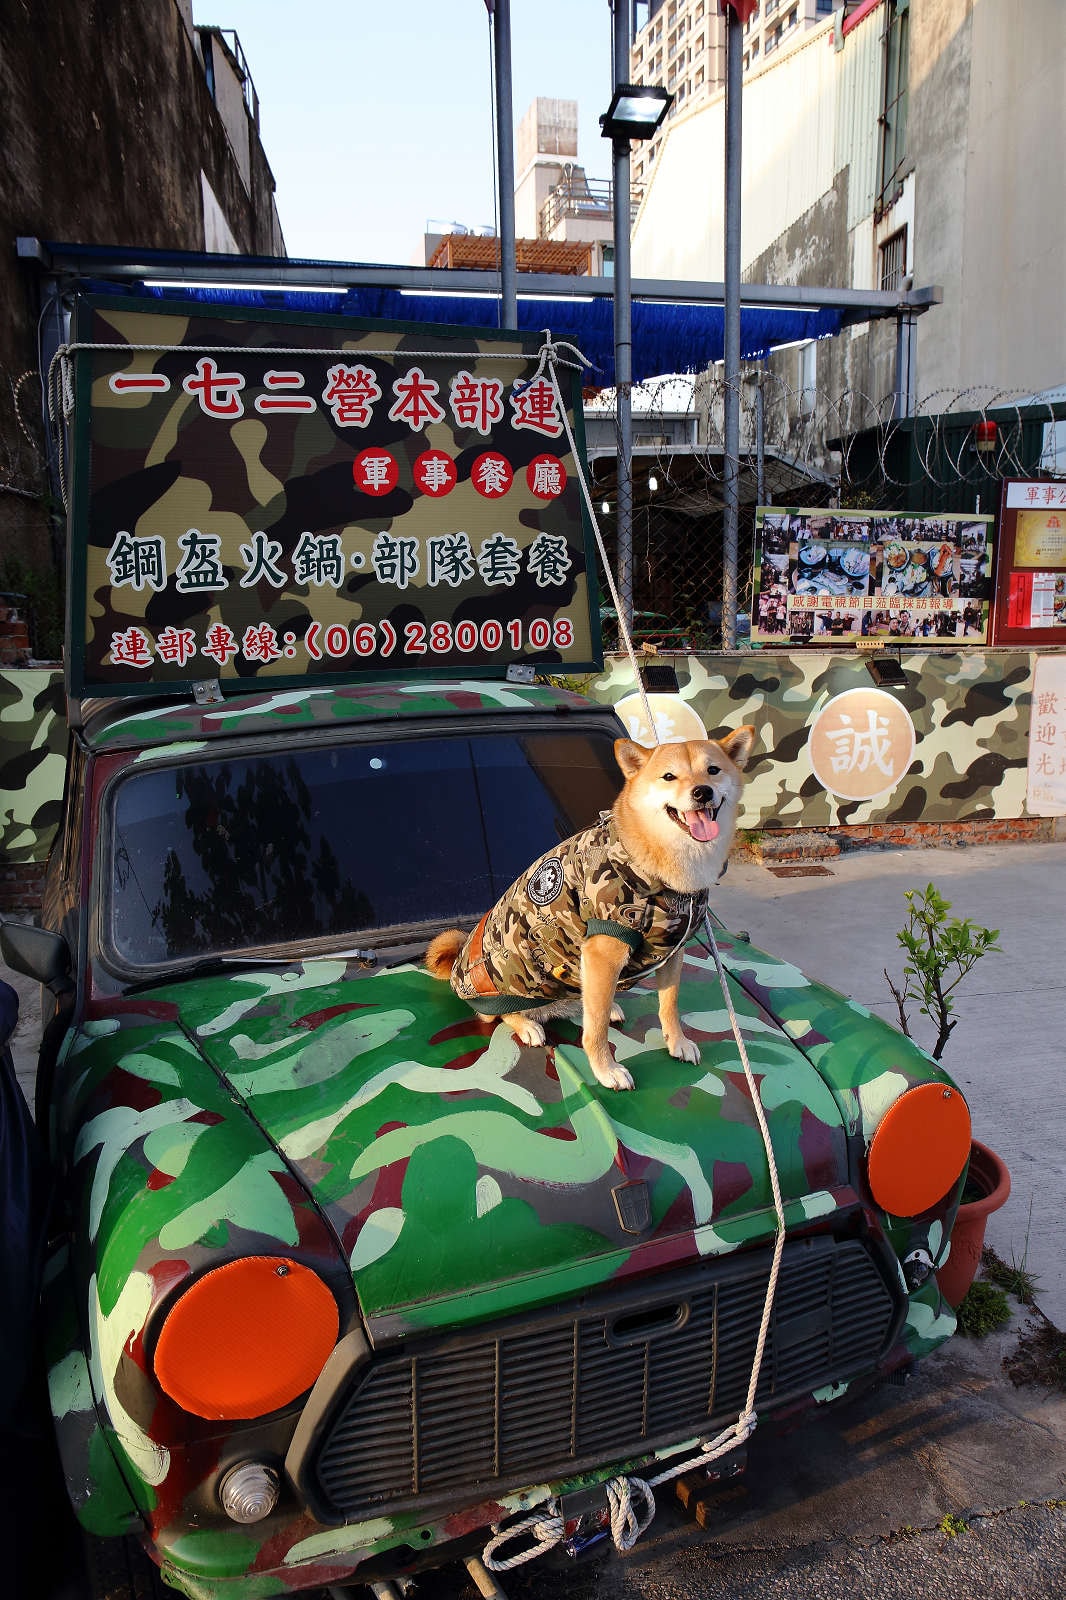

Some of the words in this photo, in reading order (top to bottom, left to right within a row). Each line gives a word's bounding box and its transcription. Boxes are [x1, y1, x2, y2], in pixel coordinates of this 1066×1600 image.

[109, 356, 565, 438] 一七二營本部連
[360, 455, 561, 495] 軍事餐廳
[825, 709, 894, 777] 誠
